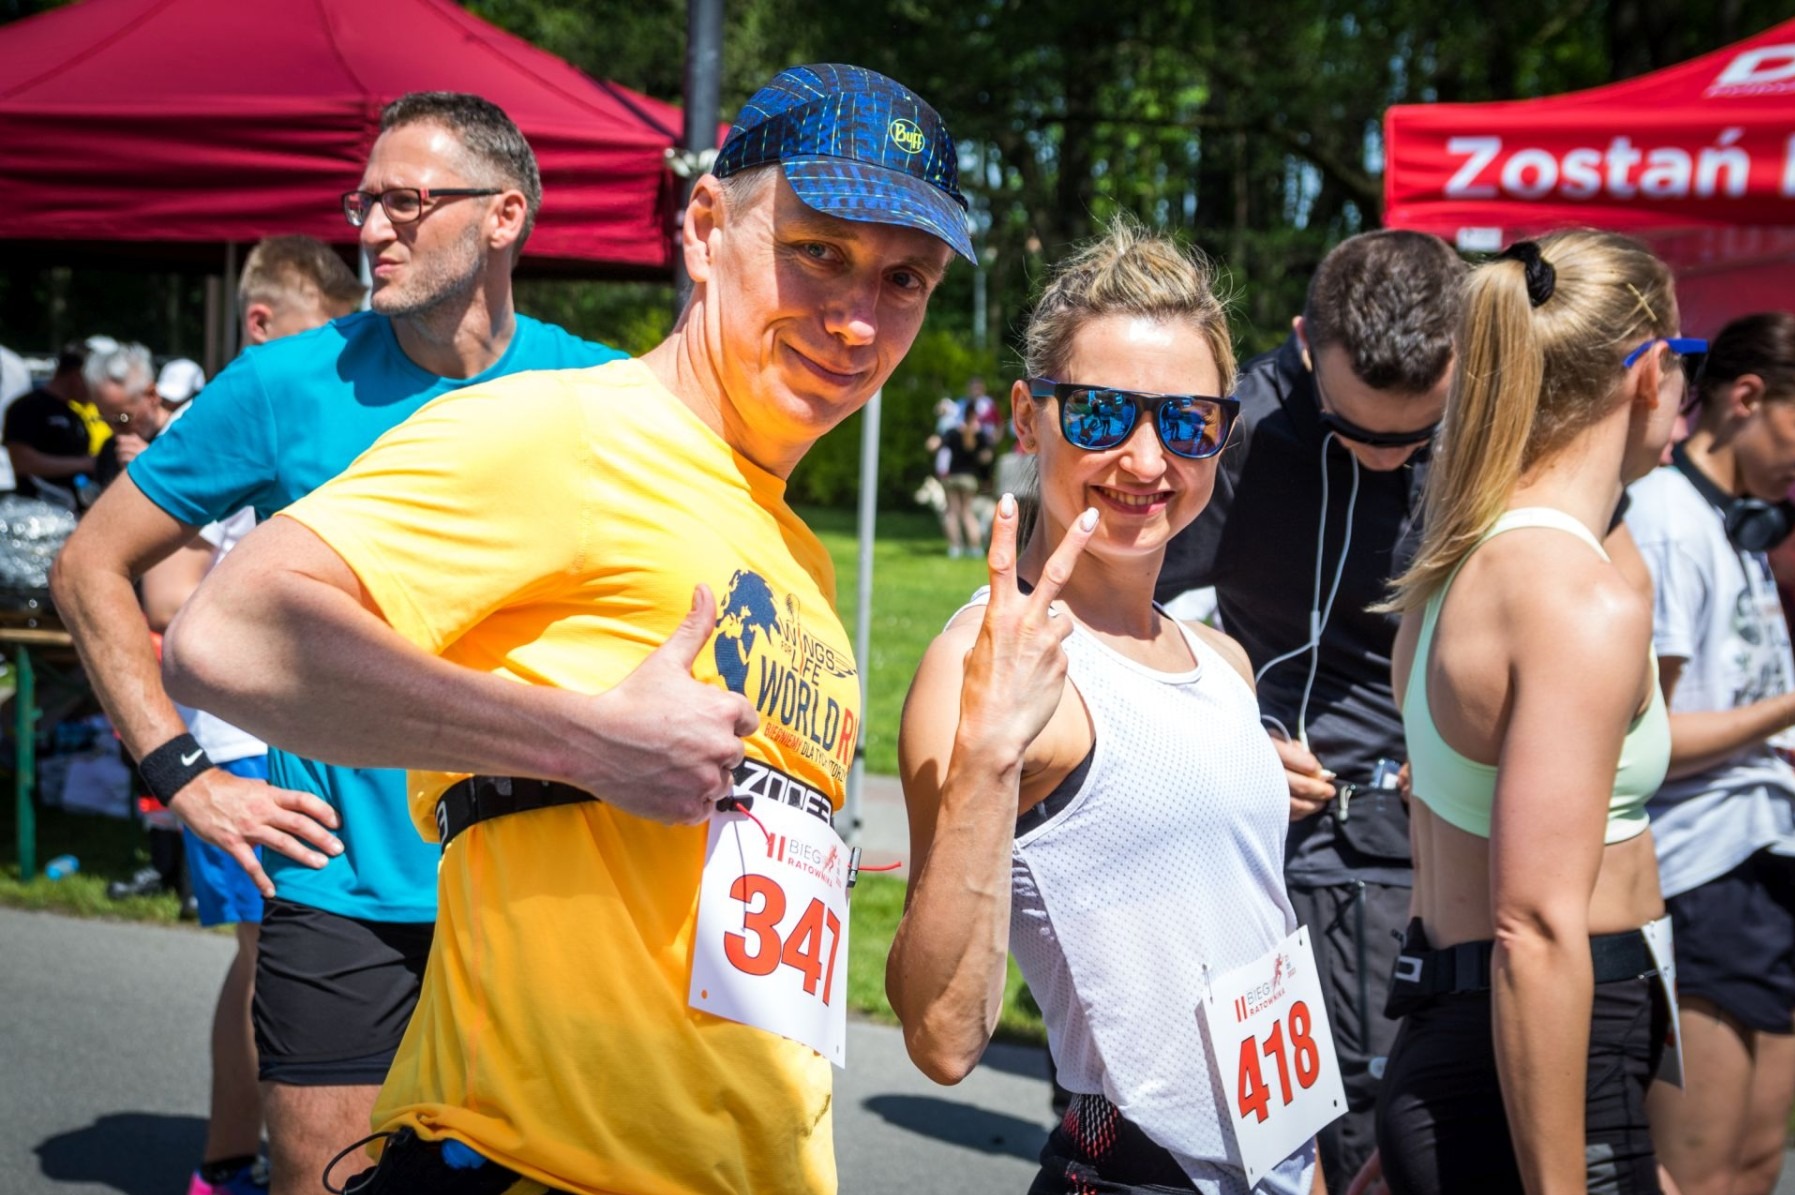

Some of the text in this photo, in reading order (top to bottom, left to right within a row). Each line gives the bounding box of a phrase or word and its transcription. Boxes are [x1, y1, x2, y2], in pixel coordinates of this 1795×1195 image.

[895, 122, 922, 150] Buff
[1444, 127, 1750, 198] Zostań
[779, 617, 835, 671] WINGS
[791, 648, 822, 687] LIFE
[756, 654, 840, 752] WORLD
[800, 740, 816, 761] DLA
[789, 839, 822, 865] BIEG
[723, 872, 841, 1008] 347
[1247, 982, 1271, 1006] BIEG
[1237, 999, 1321, 1125] 418
